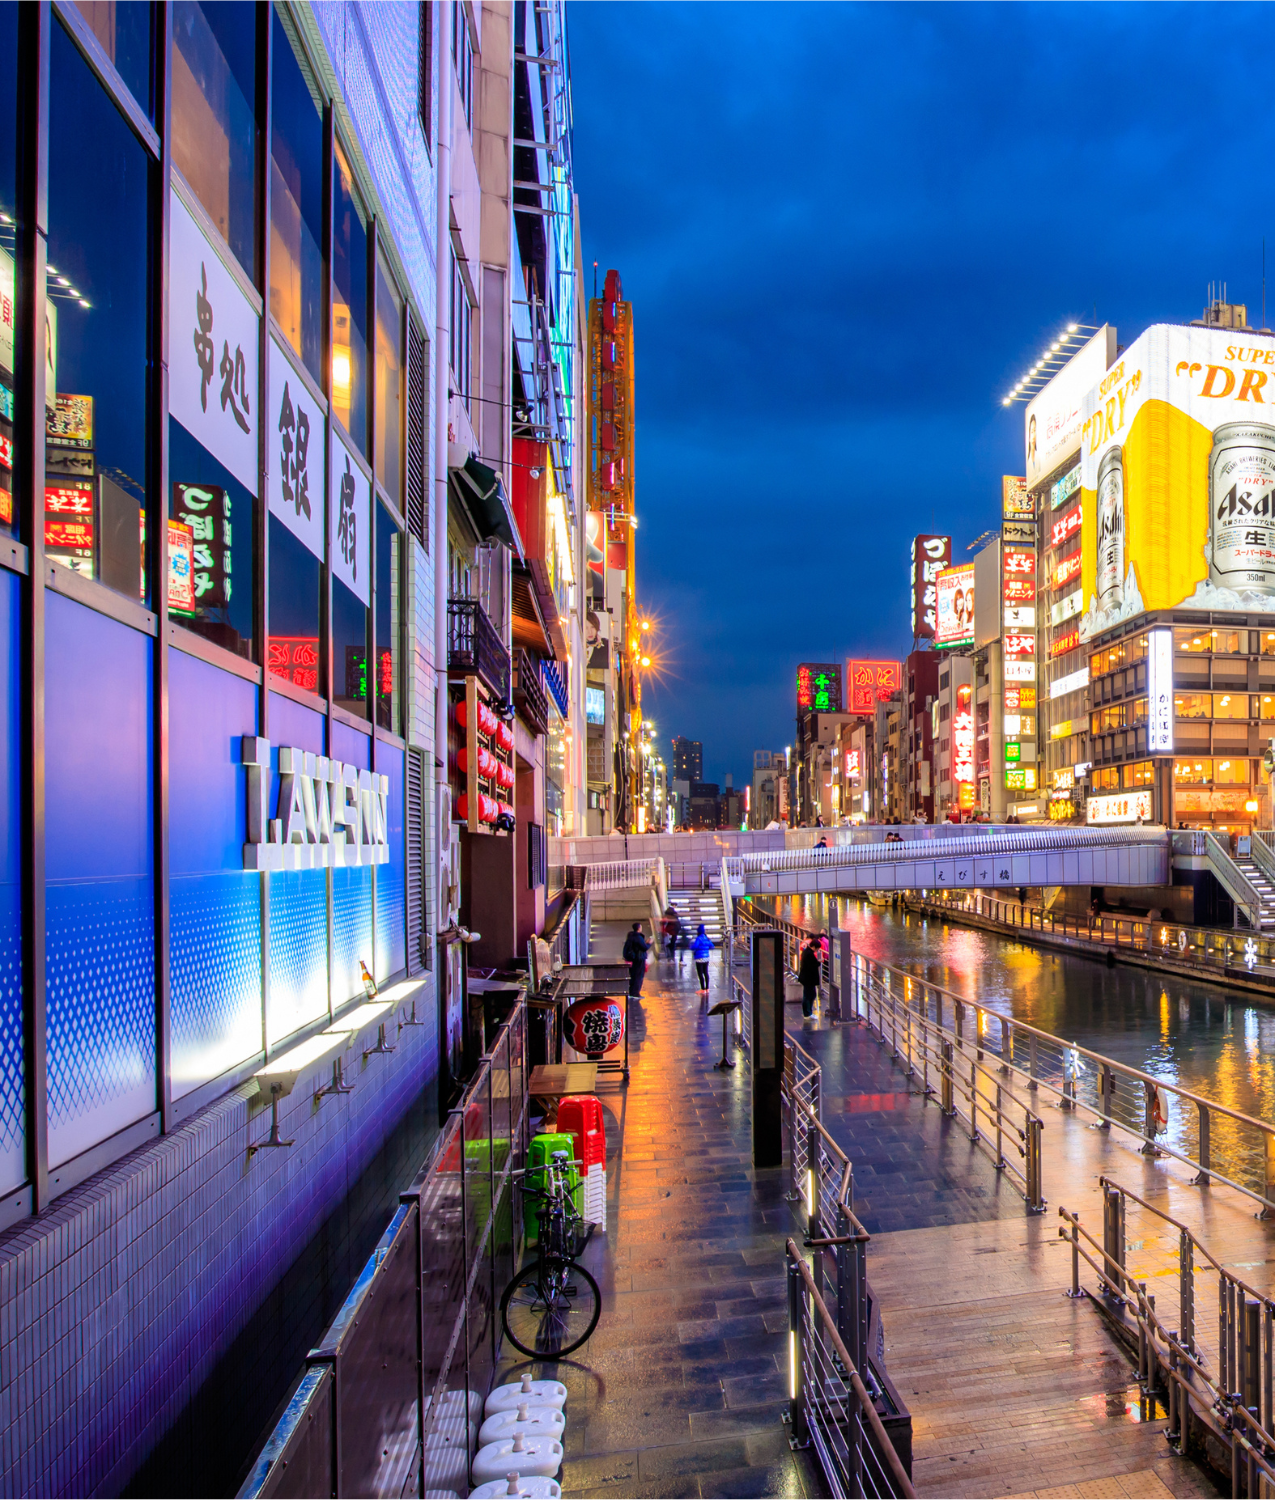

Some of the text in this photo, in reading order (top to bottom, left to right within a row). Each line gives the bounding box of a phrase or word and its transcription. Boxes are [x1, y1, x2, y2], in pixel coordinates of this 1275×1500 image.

[1099, 361, 1125, 400] SUPER
[1245, 531, 1267, 546] 生
[1246, 573, 1266, 582] 350ml
[855, 667, 895, 687] かに
[582, 1009, 609, 1052] 焼鳥
